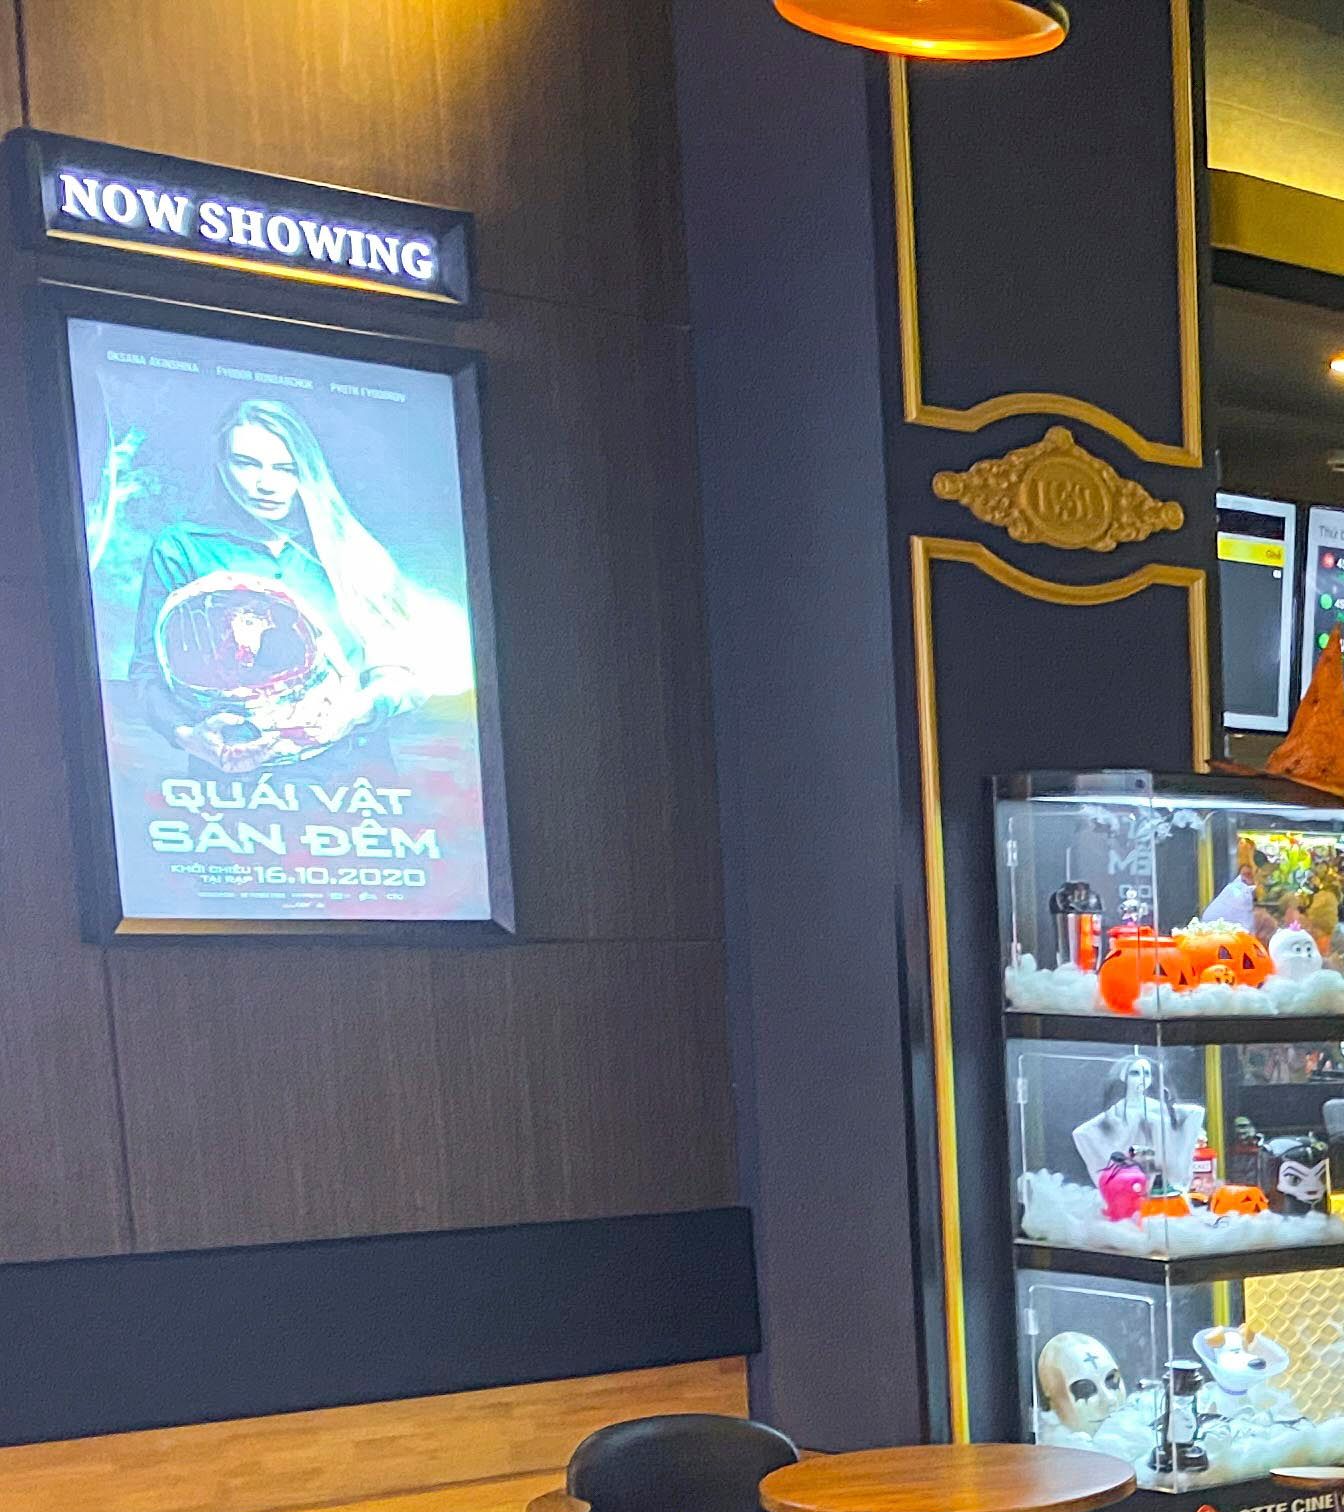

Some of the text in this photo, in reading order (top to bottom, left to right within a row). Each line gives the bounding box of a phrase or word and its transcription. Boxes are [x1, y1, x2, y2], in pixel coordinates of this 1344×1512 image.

[59, 173, 435, 280] NOW SHOWING
[161, 772, 412, 817] QUÁI VẬT
[148, 812, 442, 860] SĂN ĐÊM
[254, 865, 426, 887] 16.10.2020
